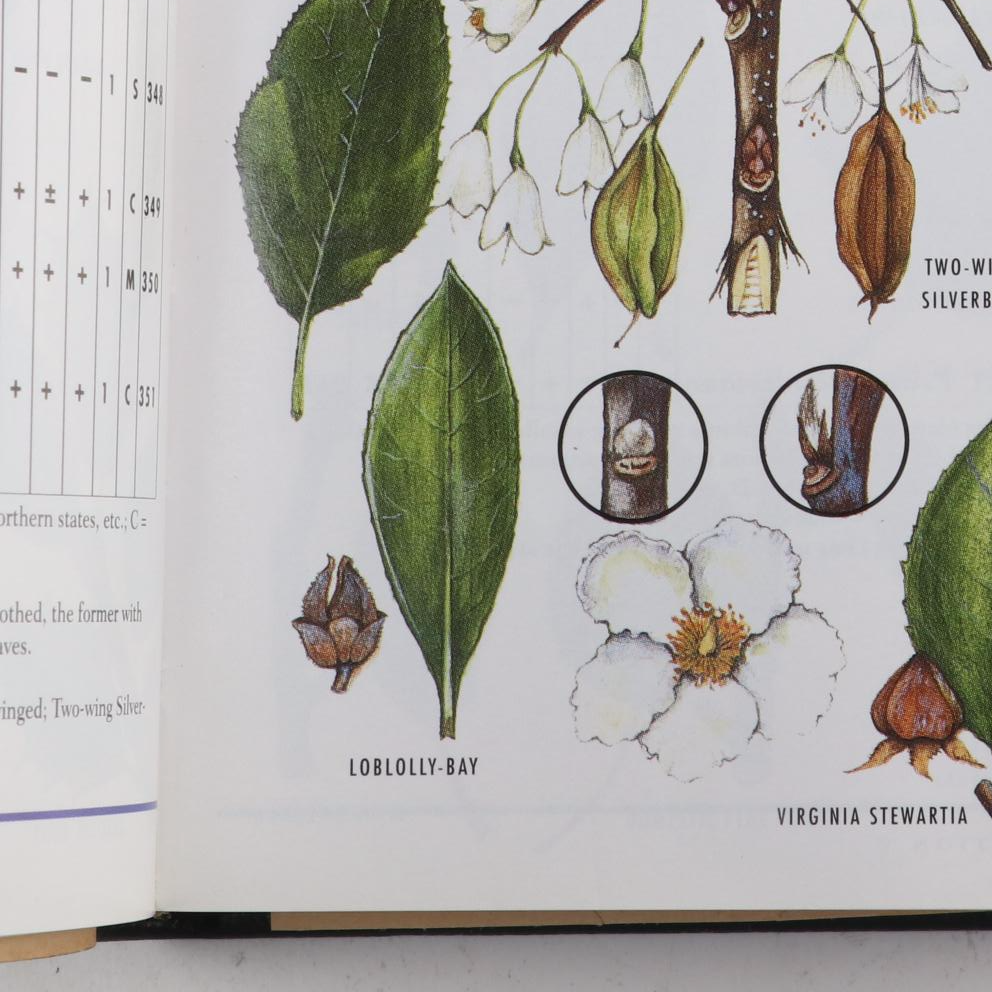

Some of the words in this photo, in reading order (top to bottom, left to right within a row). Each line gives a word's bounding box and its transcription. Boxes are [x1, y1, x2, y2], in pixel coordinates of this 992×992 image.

[147, 82, 163, 106] 348
[143, 195, 161, 218] 349
[142, 271, 159, 294] 350
[139, 385, 155, 408] 351
[58, 511, 100, 535] states,
[51, 601, 74, 623] the
[78, 600, 119, 623] former
[121, 600, 142, 623] with
[0, 697, 47, 726] inged;
[51, 697, 113, 723] Two-wing
[116, 694, 146, 717] Silver-
[349, 757, 479, 777] LOBLOLLY-BAY
[777, 806, 860, 826] VIRGINIA
[869, 806, 968, 826] STEWARTIA
